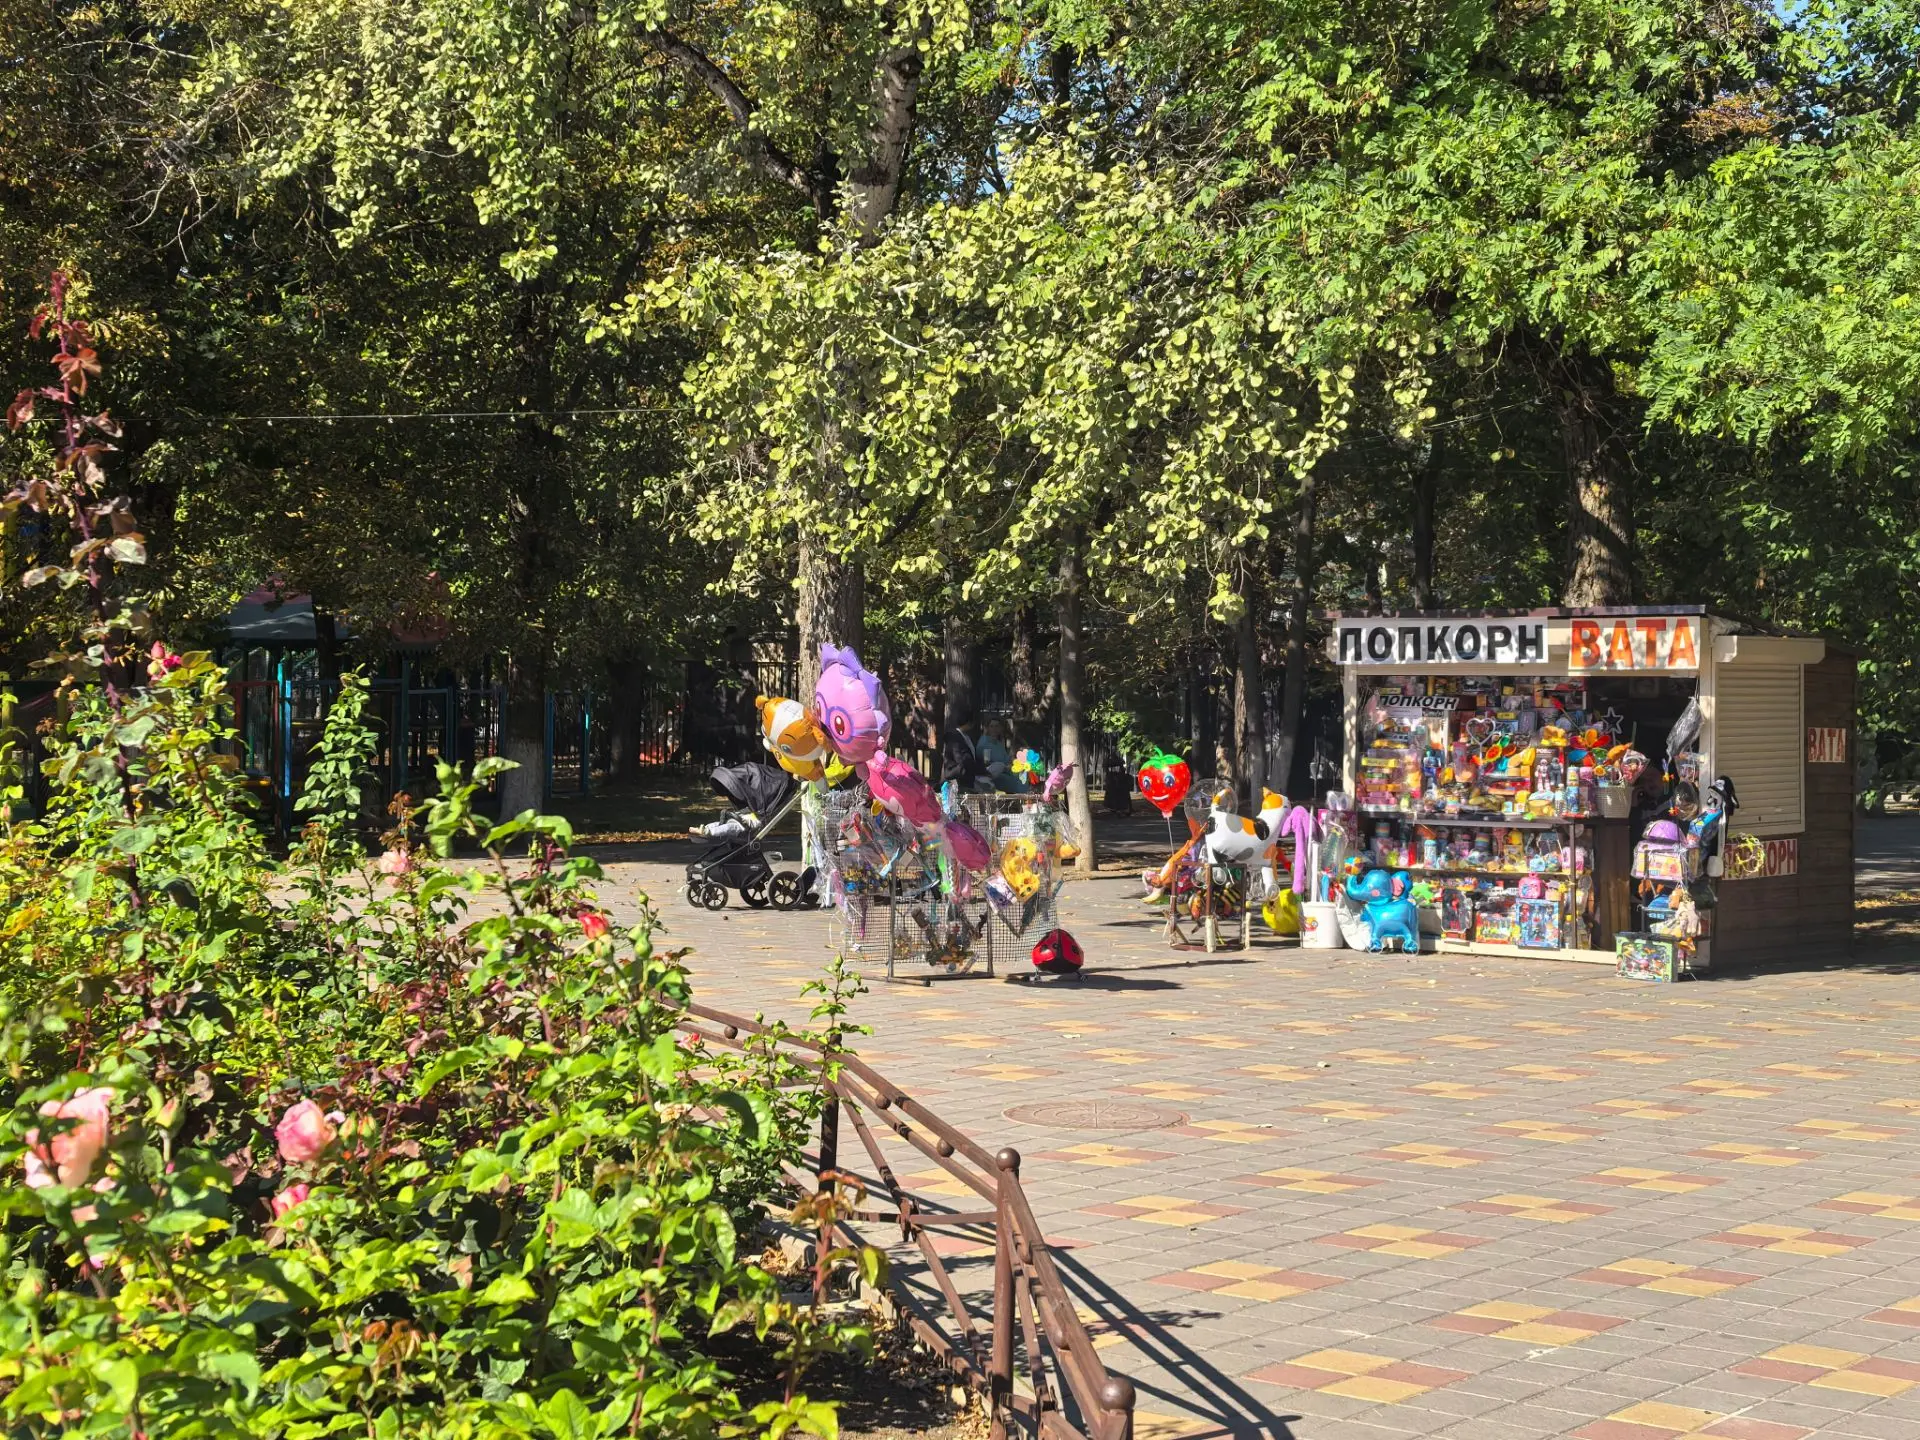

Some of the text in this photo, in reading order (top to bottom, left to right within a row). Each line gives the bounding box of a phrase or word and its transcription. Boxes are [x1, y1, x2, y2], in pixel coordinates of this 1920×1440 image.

[1339, 624, 1544, 662] ПОПКОРН
[1571, 618, 1697, 668] ВАТА
[1380, 695, 1457, 709] ПОПКОРН
[1807, 728, 1846, 761] ВАТА
